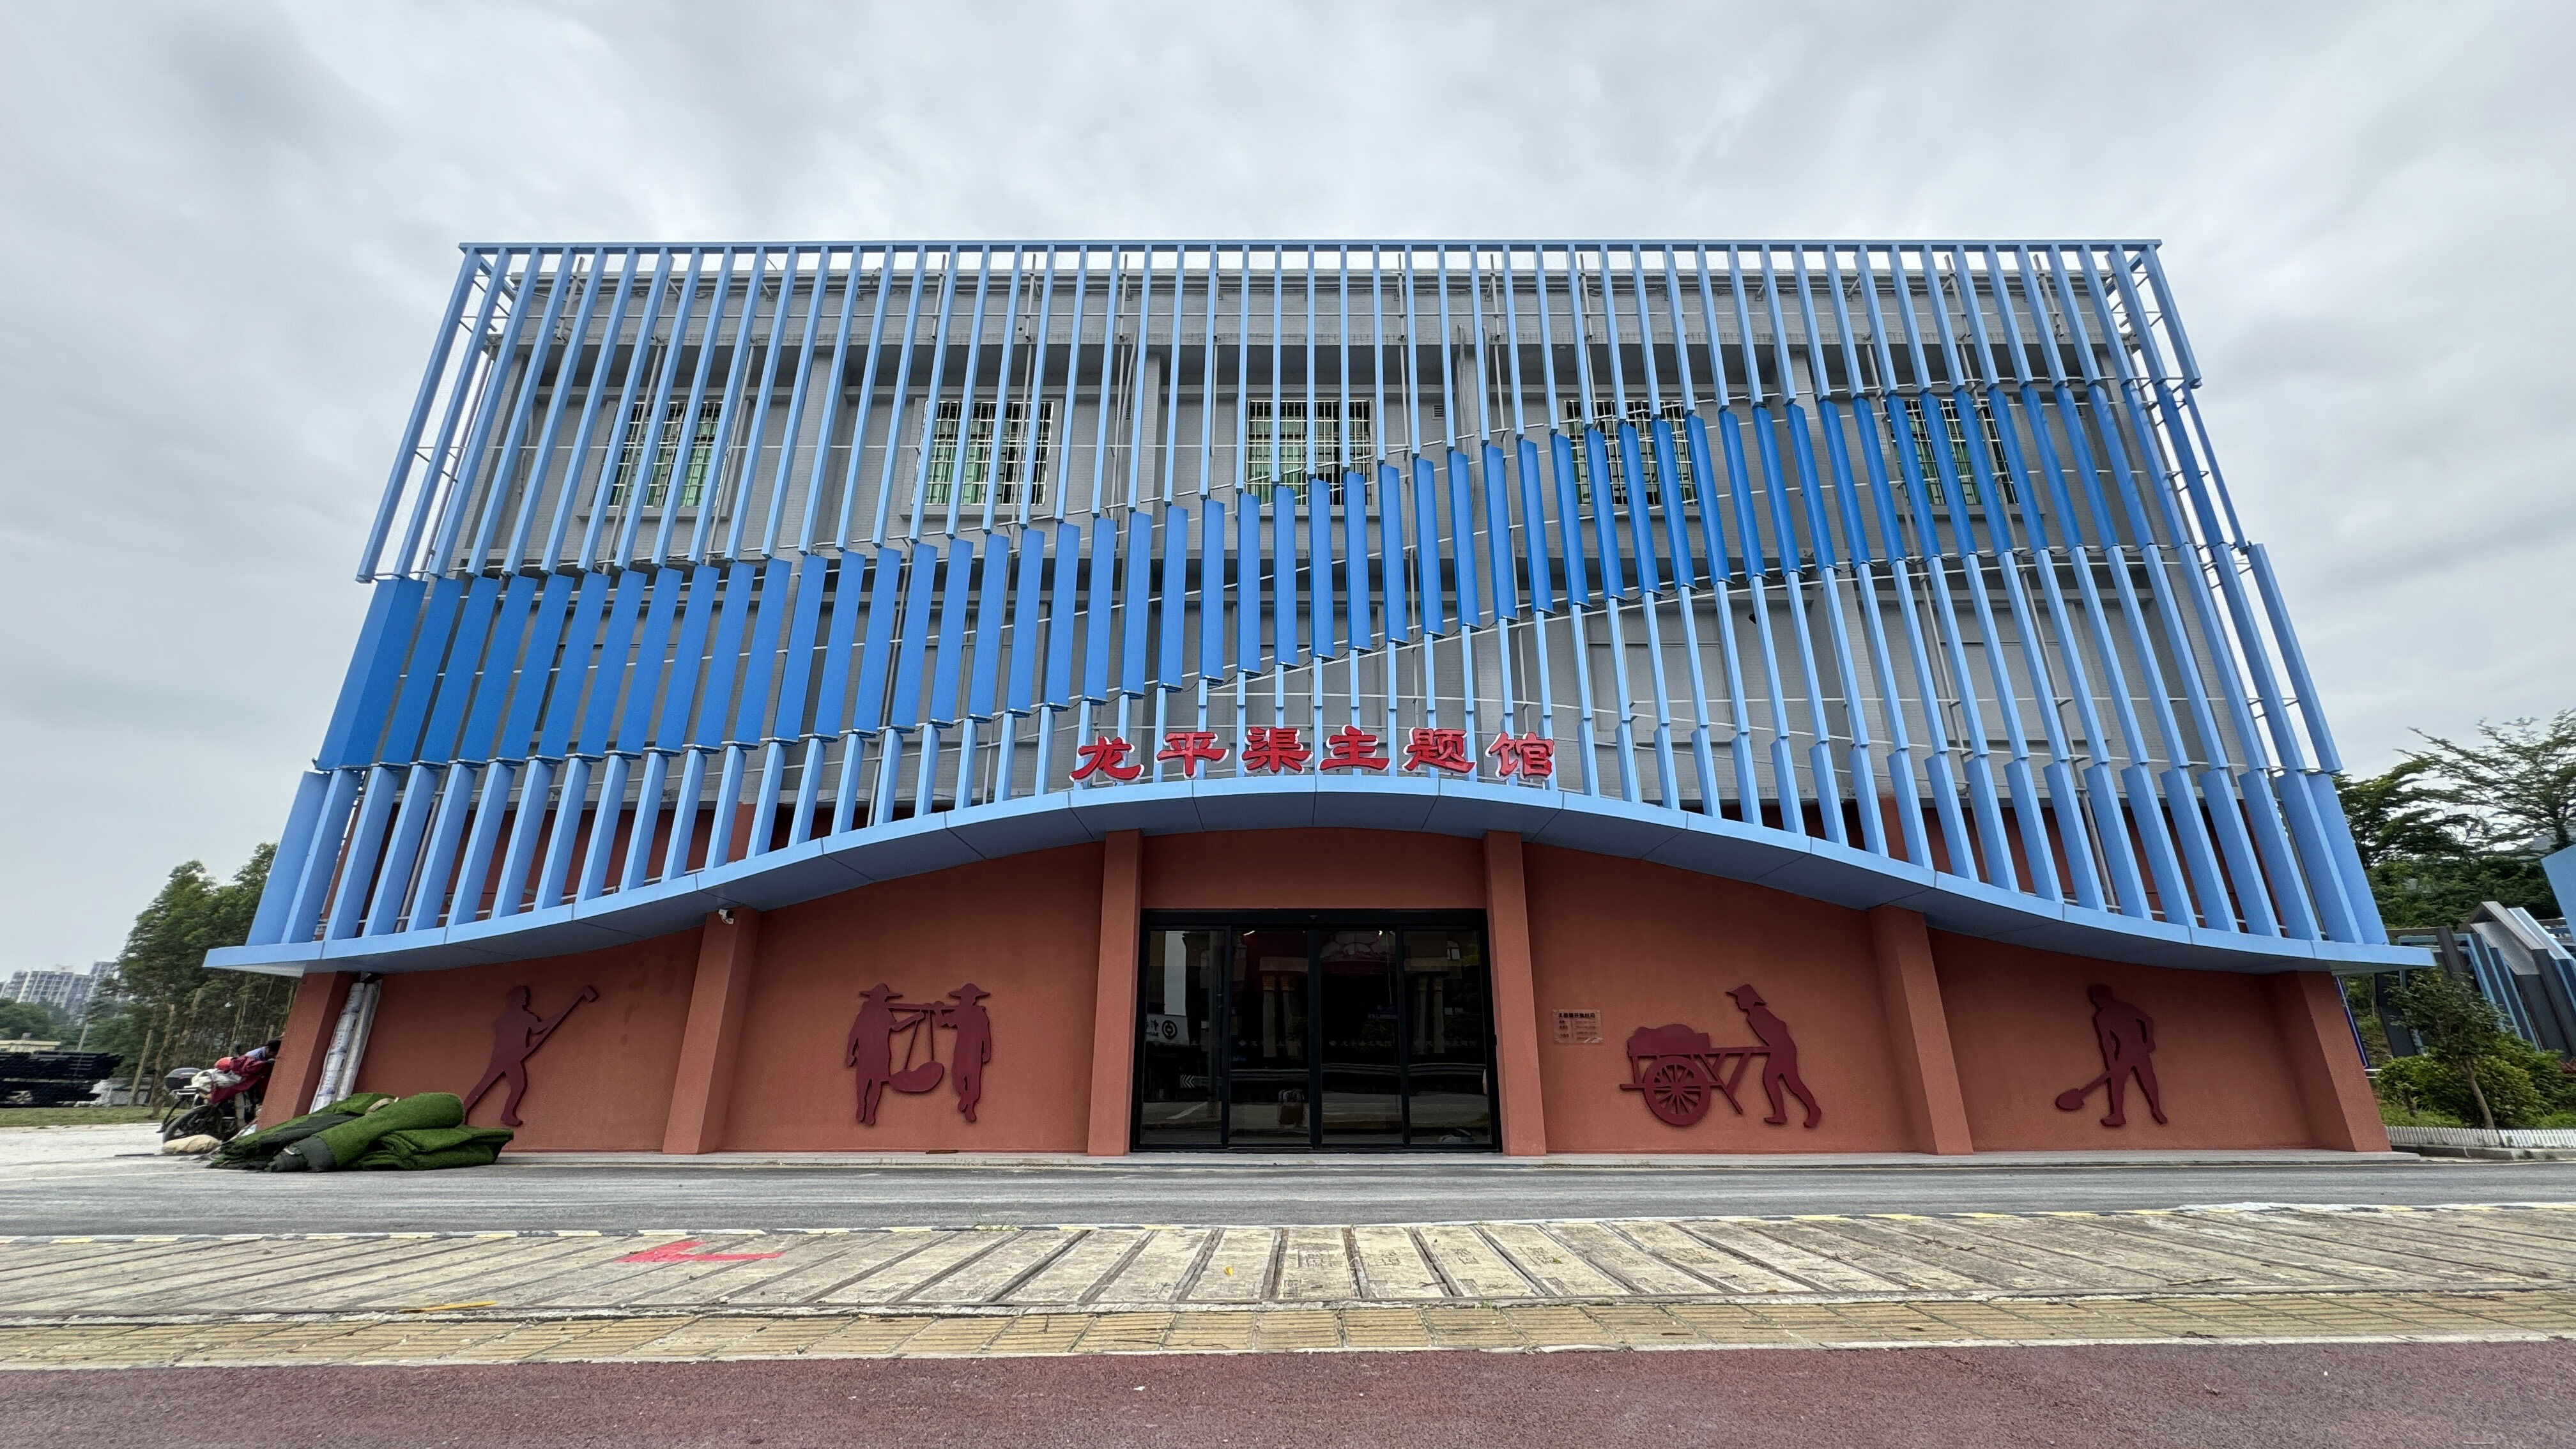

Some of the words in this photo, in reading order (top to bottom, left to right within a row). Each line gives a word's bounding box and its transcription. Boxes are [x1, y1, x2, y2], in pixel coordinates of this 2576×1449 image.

[1070, 725, 1554, 781] 龙平渠主题馆
